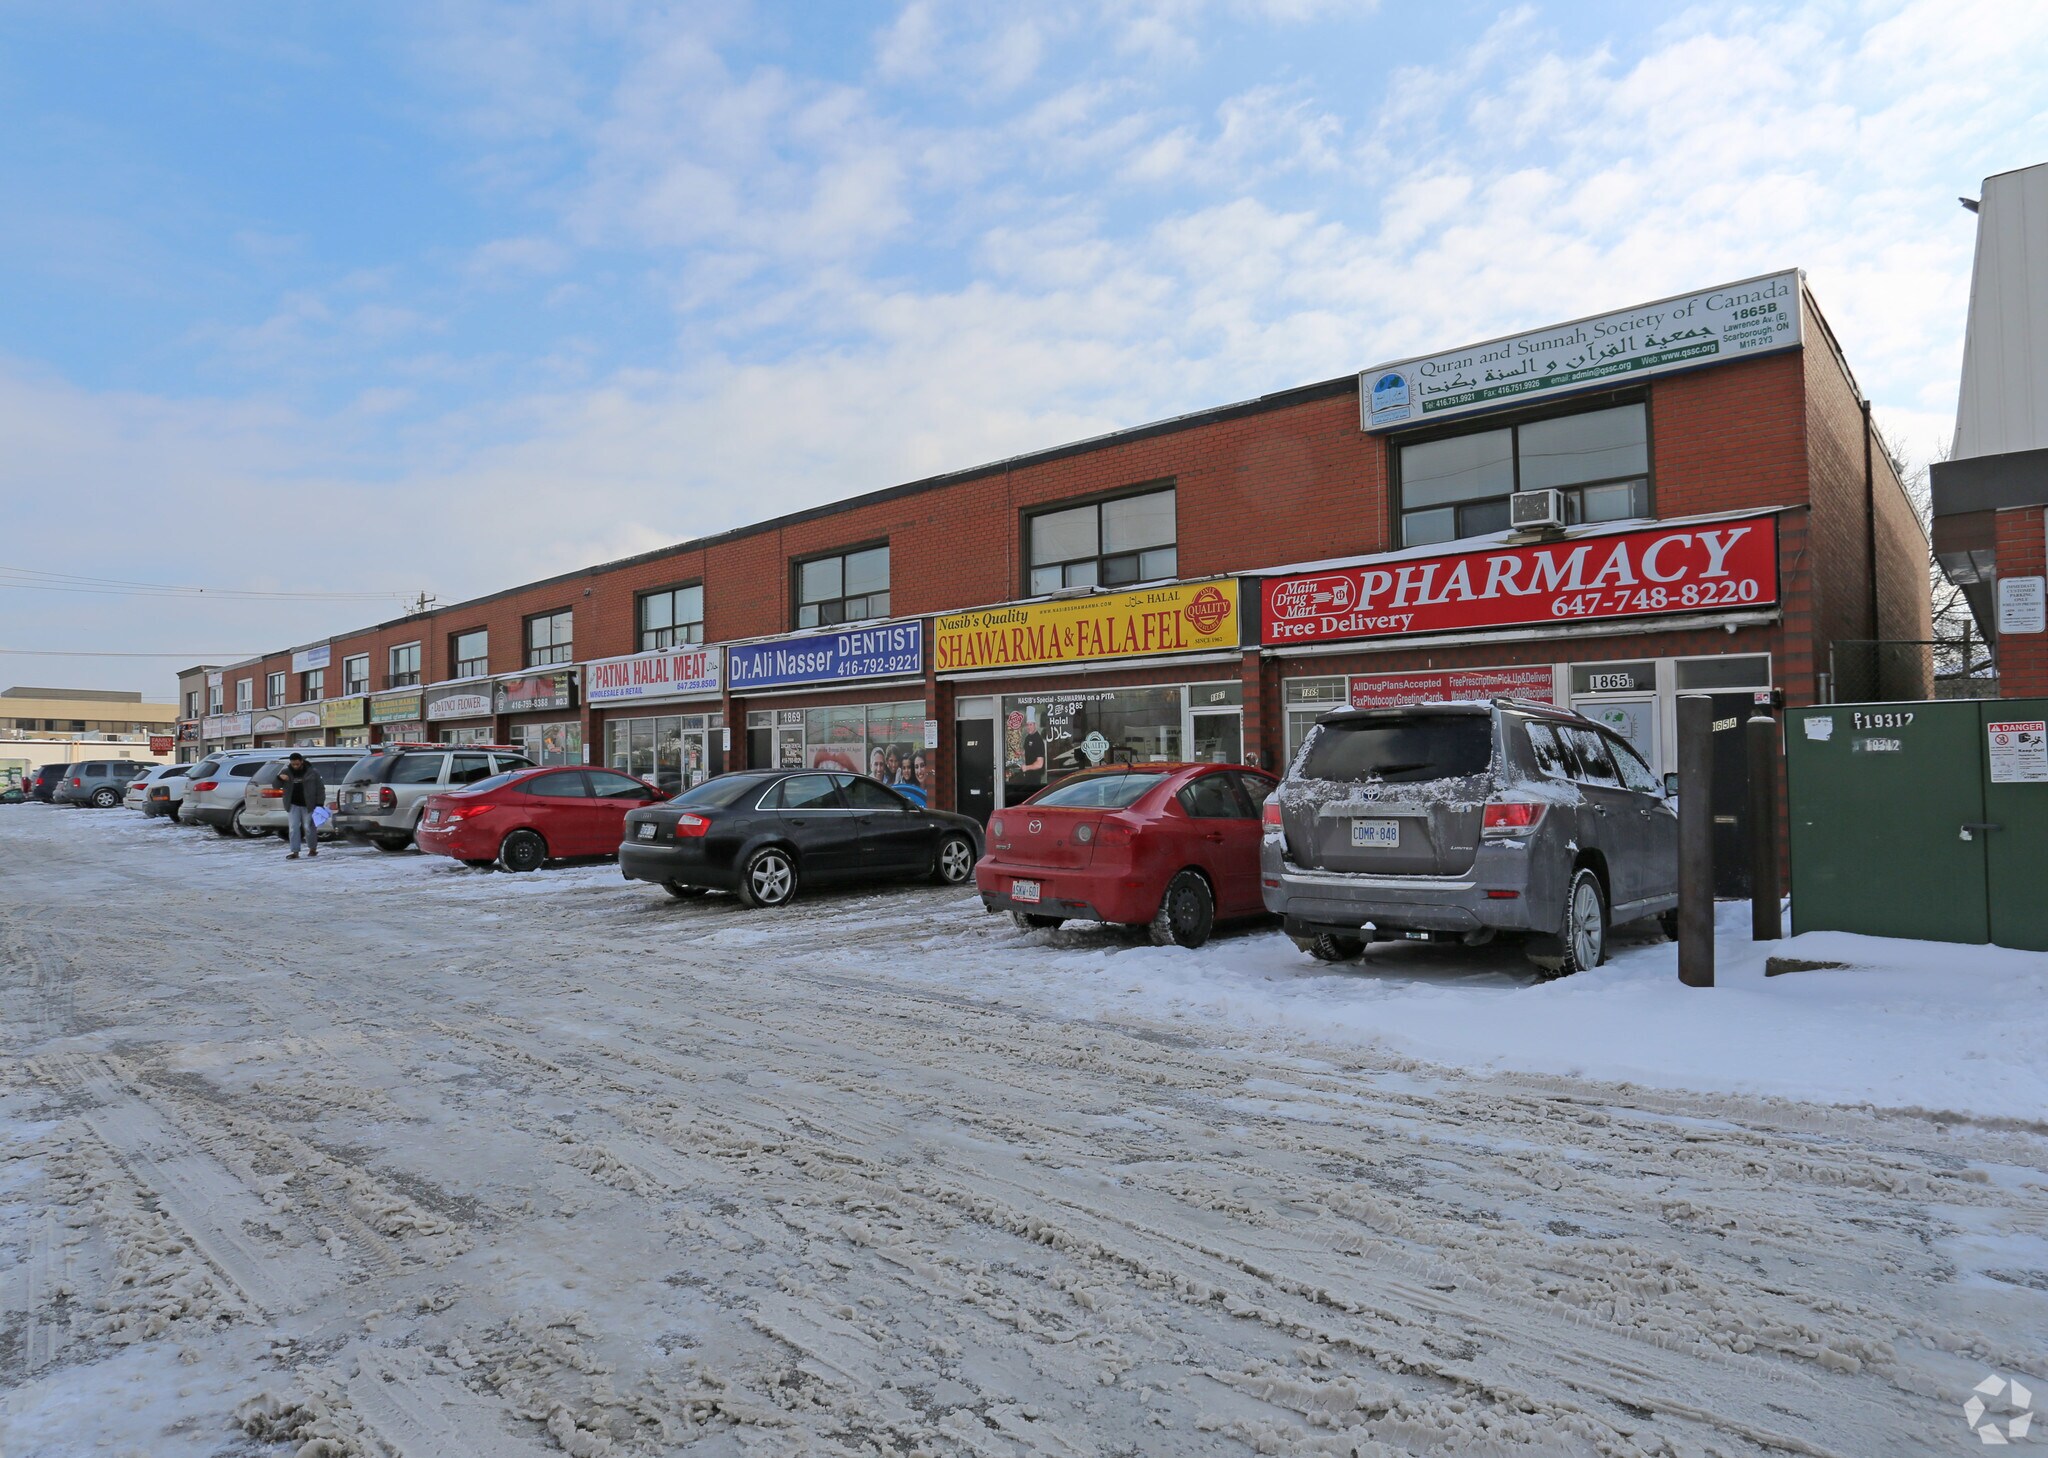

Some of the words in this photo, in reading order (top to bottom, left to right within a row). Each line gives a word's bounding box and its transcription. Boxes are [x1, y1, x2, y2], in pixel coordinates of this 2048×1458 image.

[1732, 302, 1777, 321] 1865B
[1420, 356, 1473, 377] Quran
[1479, 343, 1511, 363] and
[1517, 327, 1587, 356] Sunnah
[1594, 313, 1665, 339] Society
[1673, 298, 1698, 320] of
[1706, 280, 1790, 311] Canada
[1723, 318, 1760, 333] Lawrence
[1775, 312, 1787, 322] (E)
[1776, 322, 1789, 332] ON
[1645, 327, 1716, 350] جمعية
[1740, 339, 1757, 349] M1R
[1758, 335, 1773, 345] 2Y3
[1566, 336, 1638, 369] القرآن
[1425, 399, 1434, 410] Tel:
[1435, 392, 1475, 408] 416.751.9921
[1483, 389, 1498, 398] Fax:
[1498, 379, 1540, 395] 416.751.9926
[1551, 375, 1570, 384] email:
[1571, 361, 1632, 380] admin@qssc.org
[1642, 356, 1660, 365] Web:
[1661, 344, 1716, 361] www.qssc.org
[1485, 357, 1537, 382] السنة
[1353, 527, 1752, 611] PHARMACY
[1286, 582, 1318, 596] Main
[1147, 591, 1180, 604] HALAL
[1276, 594, 1308, 608] Drug
[1551, 578, 1759, 617] 647-748-8220
[1188, 601, 1229, 617] QUALITY
[1286, 604, 1317, 617] Mart
[938, 615, 980, 631] Nasib's
[982, 610, 1029, 628] Quality
[1272, 622, 1316, 638] Free
[1321, 613, 1414, 634] Delivery
[838, 626, 918, 657] DENTIST
[938, 622, 1064, 669] SHAWARMA
[1064, 626, 1074, 647] &
[1076, 610, 1188, 657] FALAFEL
[596, 663, 630, 689] PATNA
[633, 657, 669, 685] HALAL
[673, 652, 707, 682] MEAT
[776, 650, 833, 676] Nasser
[837, 653, 919, 676] 416-792-9221
[677, 678, 717, 690] 647.259.8500
[1592, 675, 1628, 688] 1865
[589, 688, 619, 698] WHOLESALE
[625, 686, 643, 695] RETAIL
[1036, 696, 1054, 704] Special
[1057, 694, 1086, 702] SHAWARMA
[457, 696, 481, 710] FLOWER
[1047, 703, 1054, 717] 2
[783, 711, 801, 722] 1869
[1049, 717, 1068, 725] Halal
[1046, 726, 1072, 742] حلال
[1083, 740, 1108, 749] QUALITY
[1353, 827, 1375, 840] CDMR
[1380, 828, 1397, 840] 848
